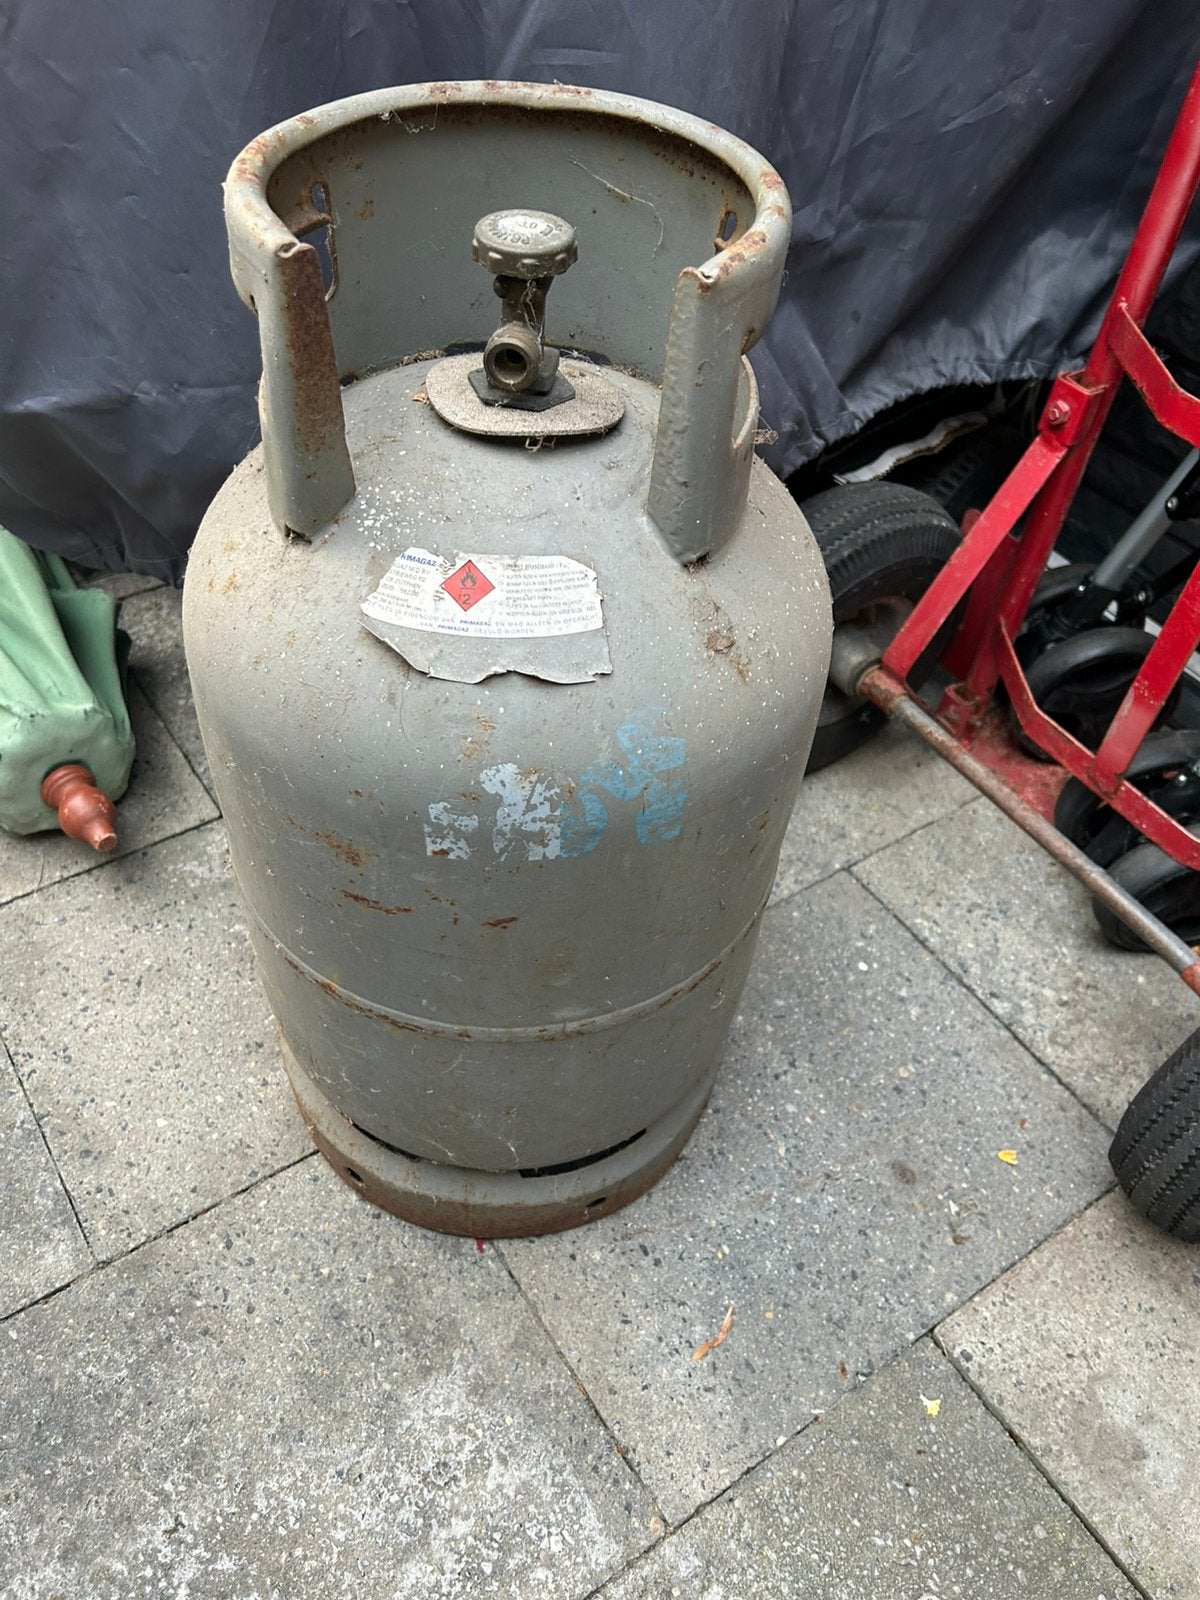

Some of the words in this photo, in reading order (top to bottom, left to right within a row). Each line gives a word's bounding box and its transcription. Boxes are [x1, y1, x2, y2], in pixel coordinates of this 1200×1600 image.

[462, 593, 471, 606] 2
[459, 619, 491, 627] PRIMAGAZ
[437, 624, 469, 632] PRIMAGAZ
